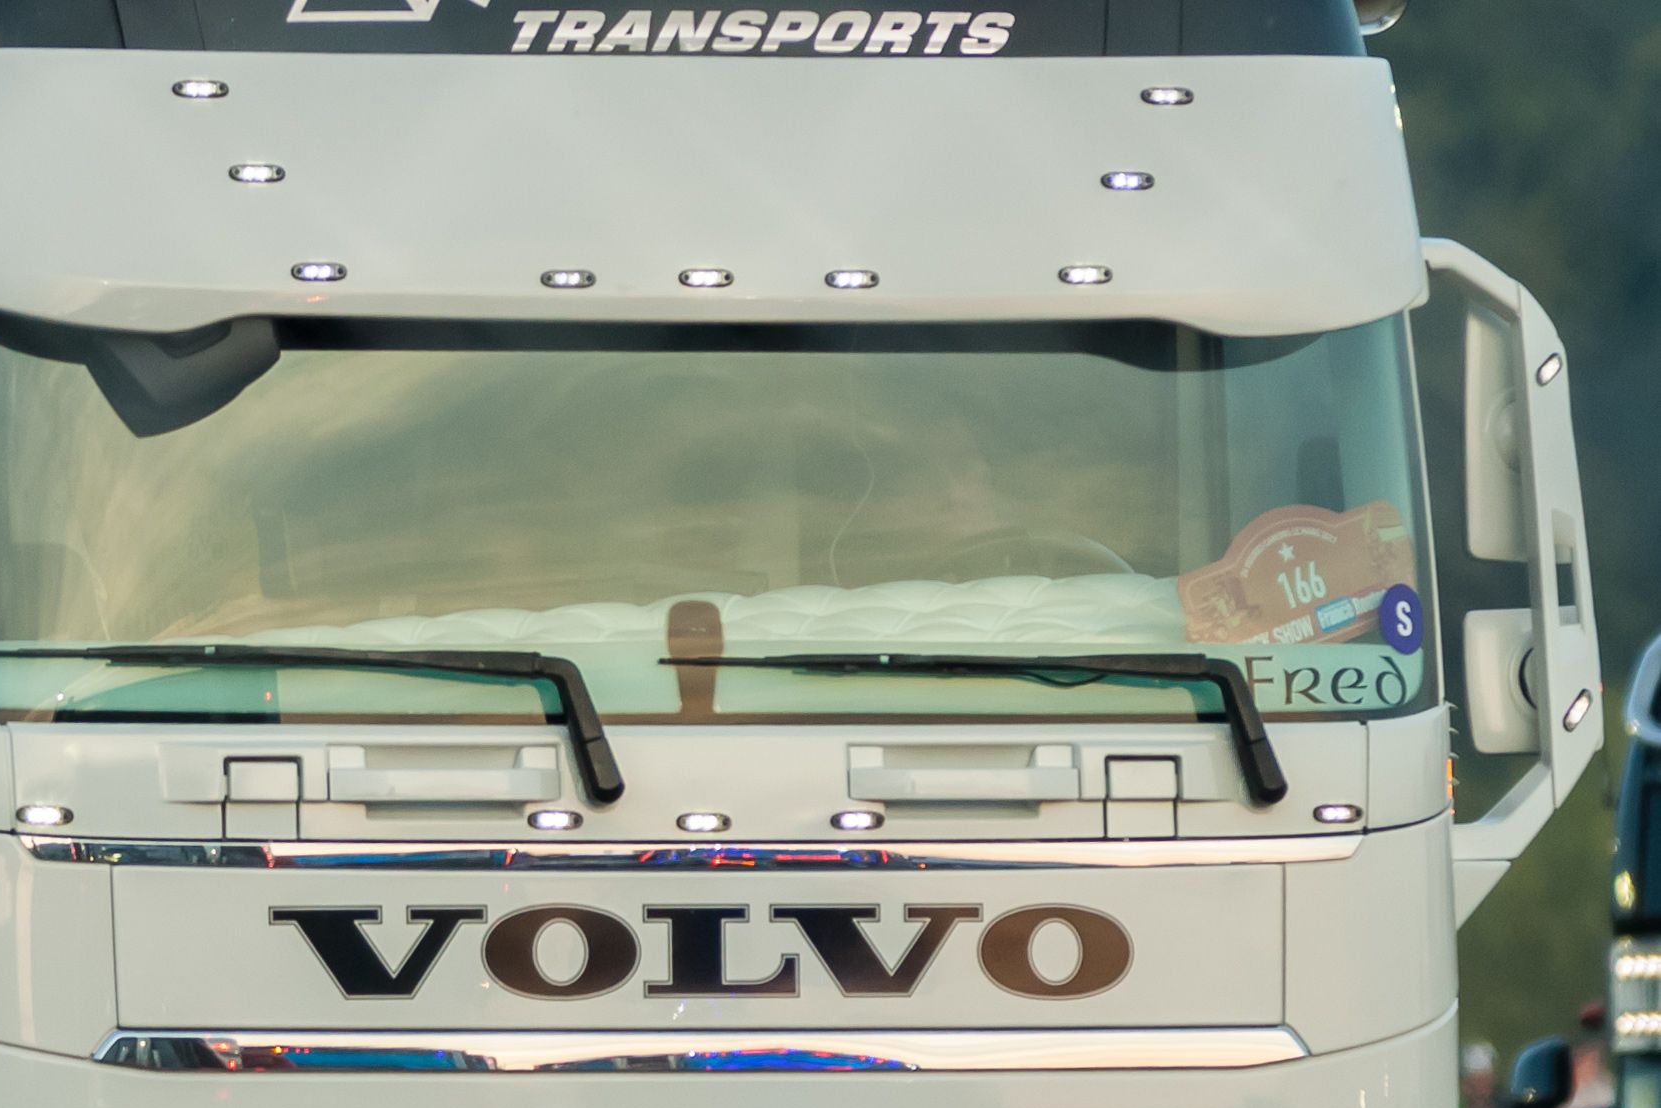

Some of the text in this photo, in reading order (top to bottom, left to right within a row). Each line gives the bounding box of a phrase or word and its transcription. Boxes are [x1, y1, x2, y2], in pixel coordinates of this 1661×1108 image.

[511, 10, 1016, 55] TRANSPORTS
[1277, 560, 1327, 610] 166
[1395, 600, 1413, 637] S
[267, 901, 1134, 1002] VOLVO
